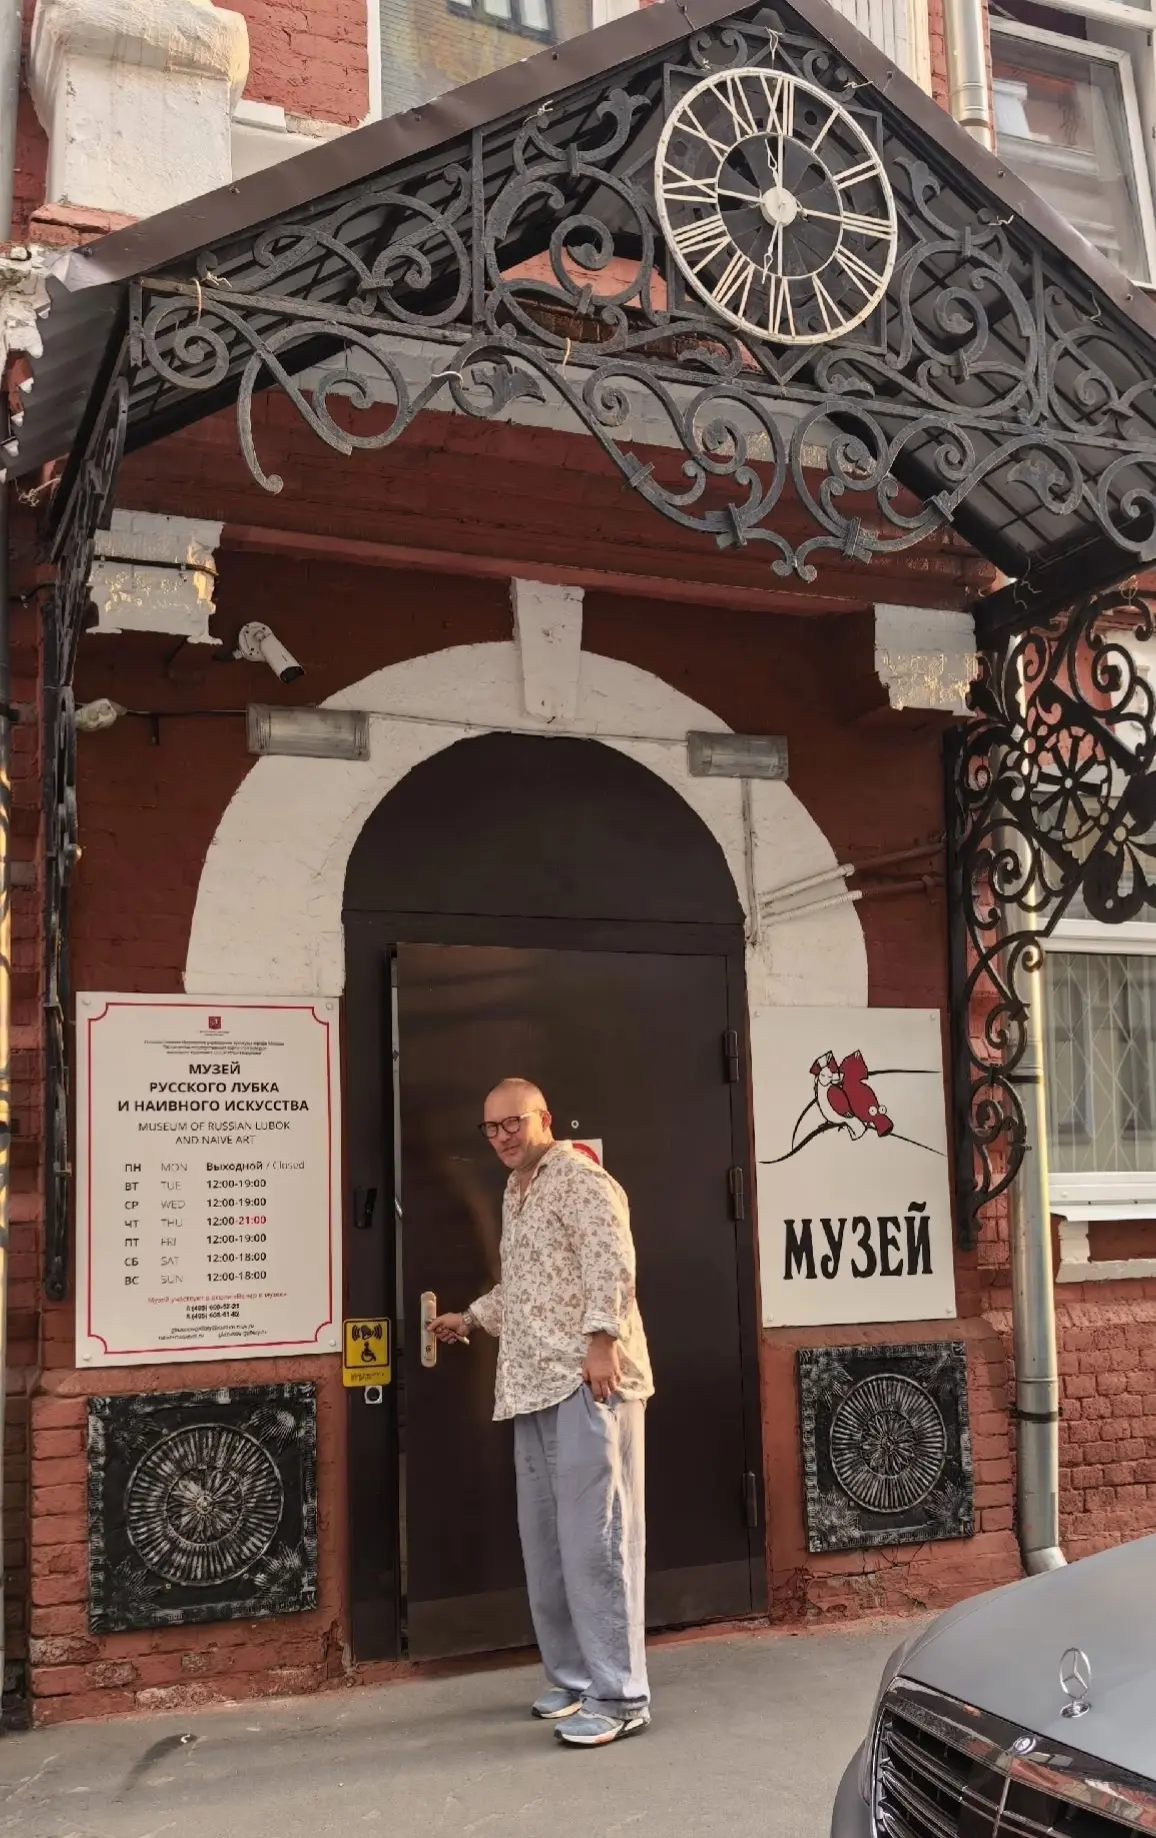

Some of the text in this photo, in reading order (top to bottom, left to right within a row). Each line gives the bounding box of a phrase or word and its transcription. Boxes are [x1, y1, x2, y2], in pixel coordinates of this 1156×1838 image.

[189, 1061, 241, 1075] МУЗЕЙ
[150, 1082, 279, 1093] РУССКОГО ЛУБКА
[118, 1100, 309, 1111] И НАИВНОГО ИСКУССТВА
[138, 1121, 291, 1132] MUSEUM OF RUSSIAN LUBOK
[175, 1135, 256, 1145] AND NAIVE ART
[125, 1163, 141, 1172] ПН
[161, 1163, 188, 1172] MON
[206, 1161, 263, 1172] Выходной
[125, 1182, 139, 1191] ВТ
[160, 1181, 181, 1191] TUE
[207, 1179, 266, 1189] 12:00-19:00
[125, 1201, 139, 1210] СР
[160, 1200, 186, 1210] WED
[207, 1198, 266, 1208] 12:00-19:00
[125, 1220, 139, 1228] ЧТ
[160, 1218, 183, 1228] THU
[207, 1215, 266, 1226] 12:00-21:00
[125, 1238, 139, 1247] ПТ
[160, 1238, 177, 1247] FRI
[783, 1201, 933, 1280] МУЗЕЙ
[125, 1257, 139, 1266] СБ
[160, 1256, 180, 1266] SAT
[207, 1252, 266, 1263] 12:00-18:00
[125, 1276, 139, 1285] ВС
[160, 1275, 183, 1284] SUN
[207, 1271, 266, 1282] 12:00-18:00
